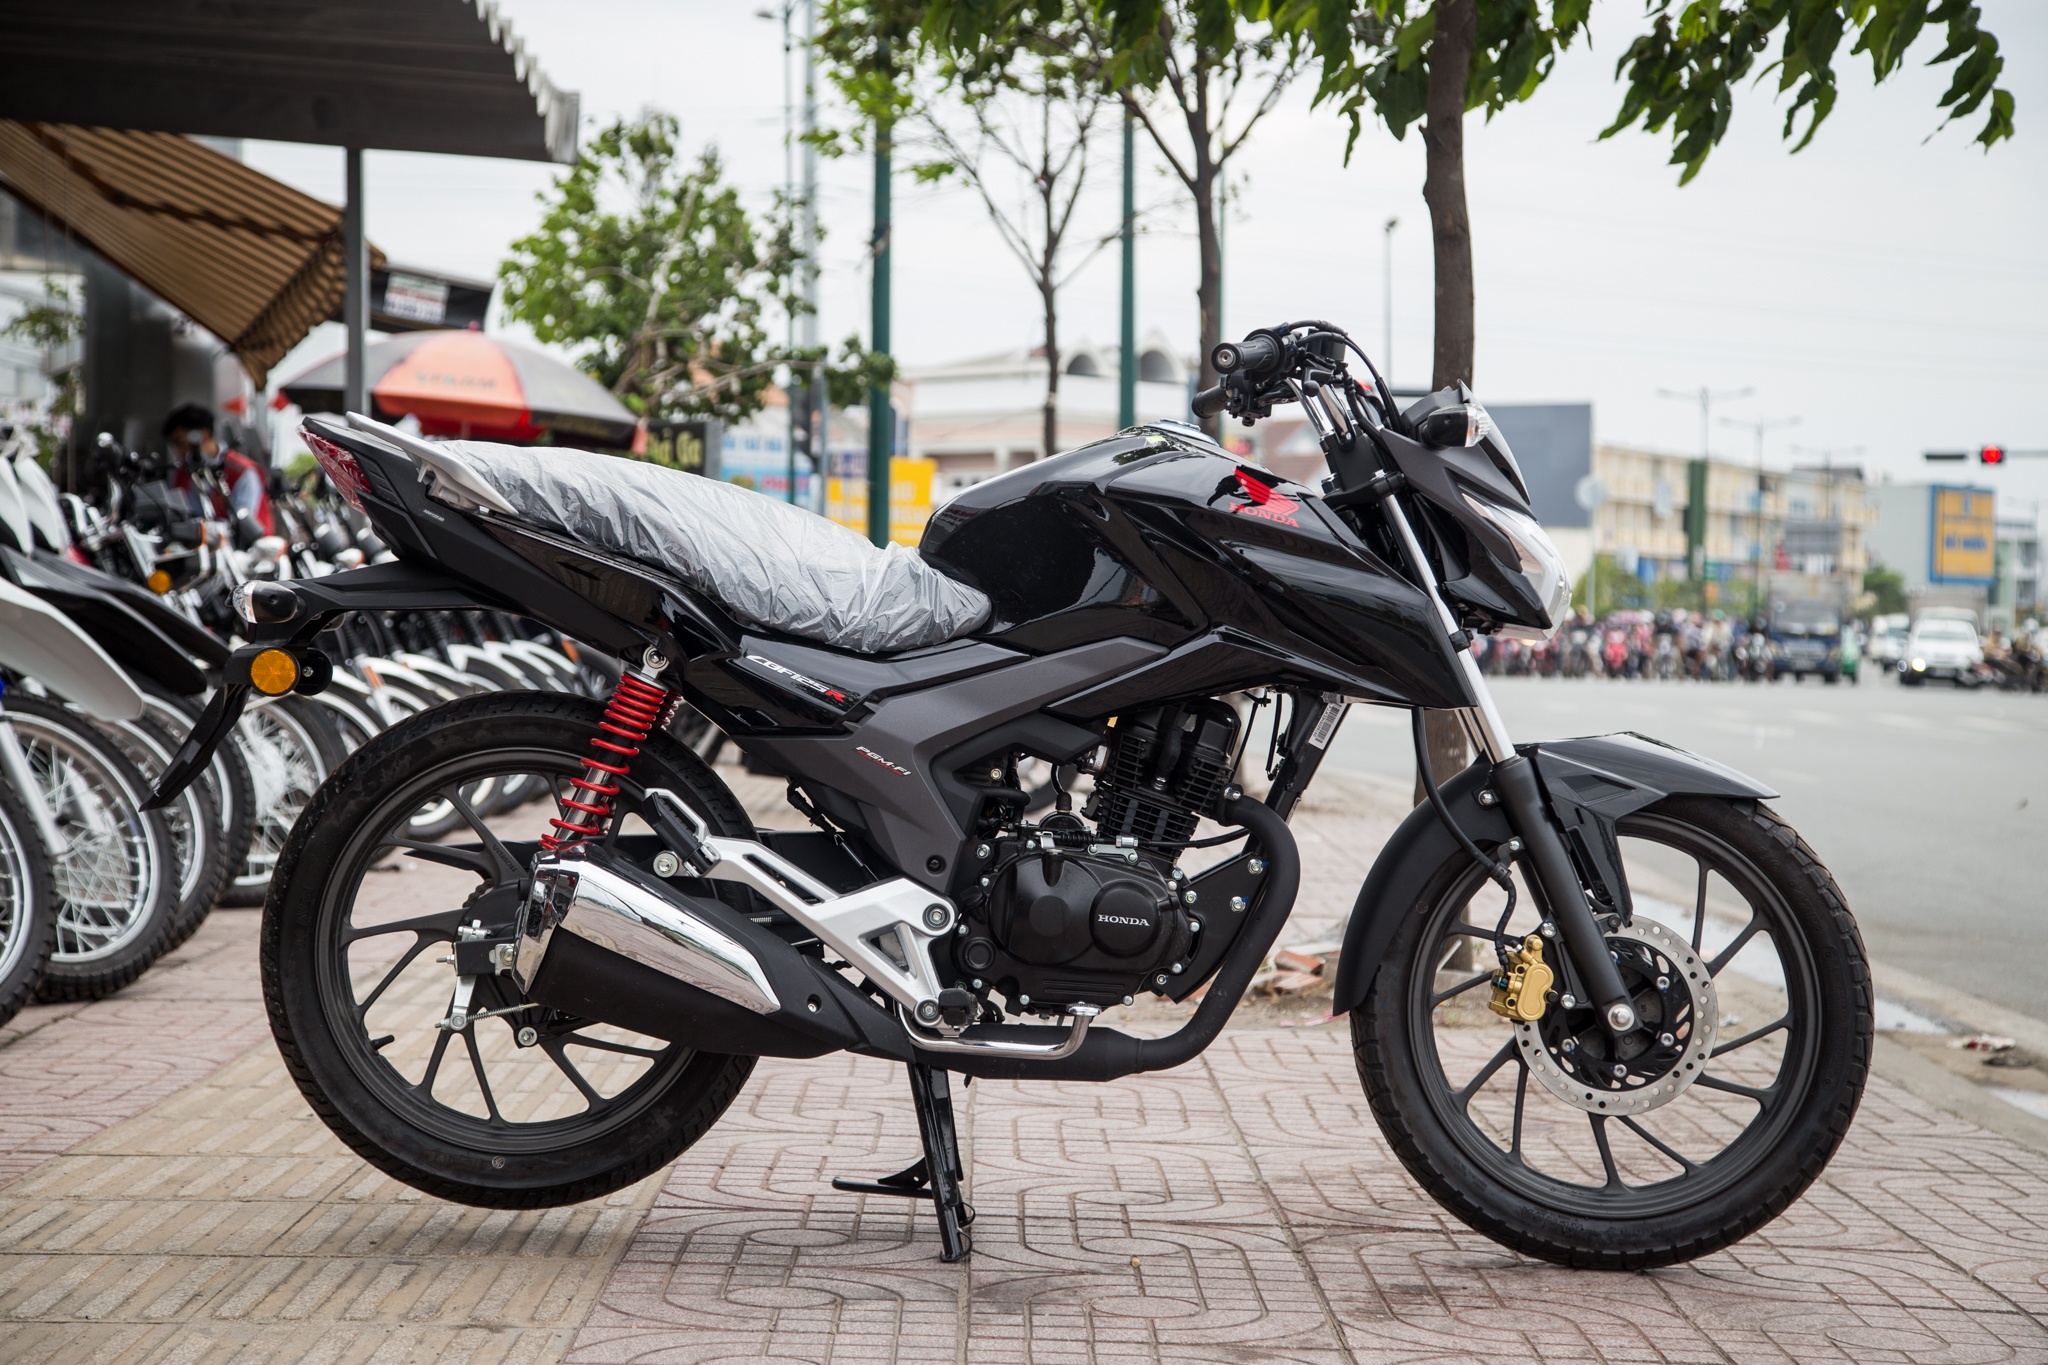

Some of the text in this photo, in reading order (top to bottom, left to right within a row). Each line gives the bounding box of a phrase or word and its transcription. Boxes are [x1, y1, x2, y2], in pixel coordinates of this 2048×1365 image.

[1228, 502, 1300, 528] HONDA
[746, 654, 845, 703] CBF125R
[856, 746, 912, 776] PGM-FI
[1097, 914, 1150, 927] HONDA
